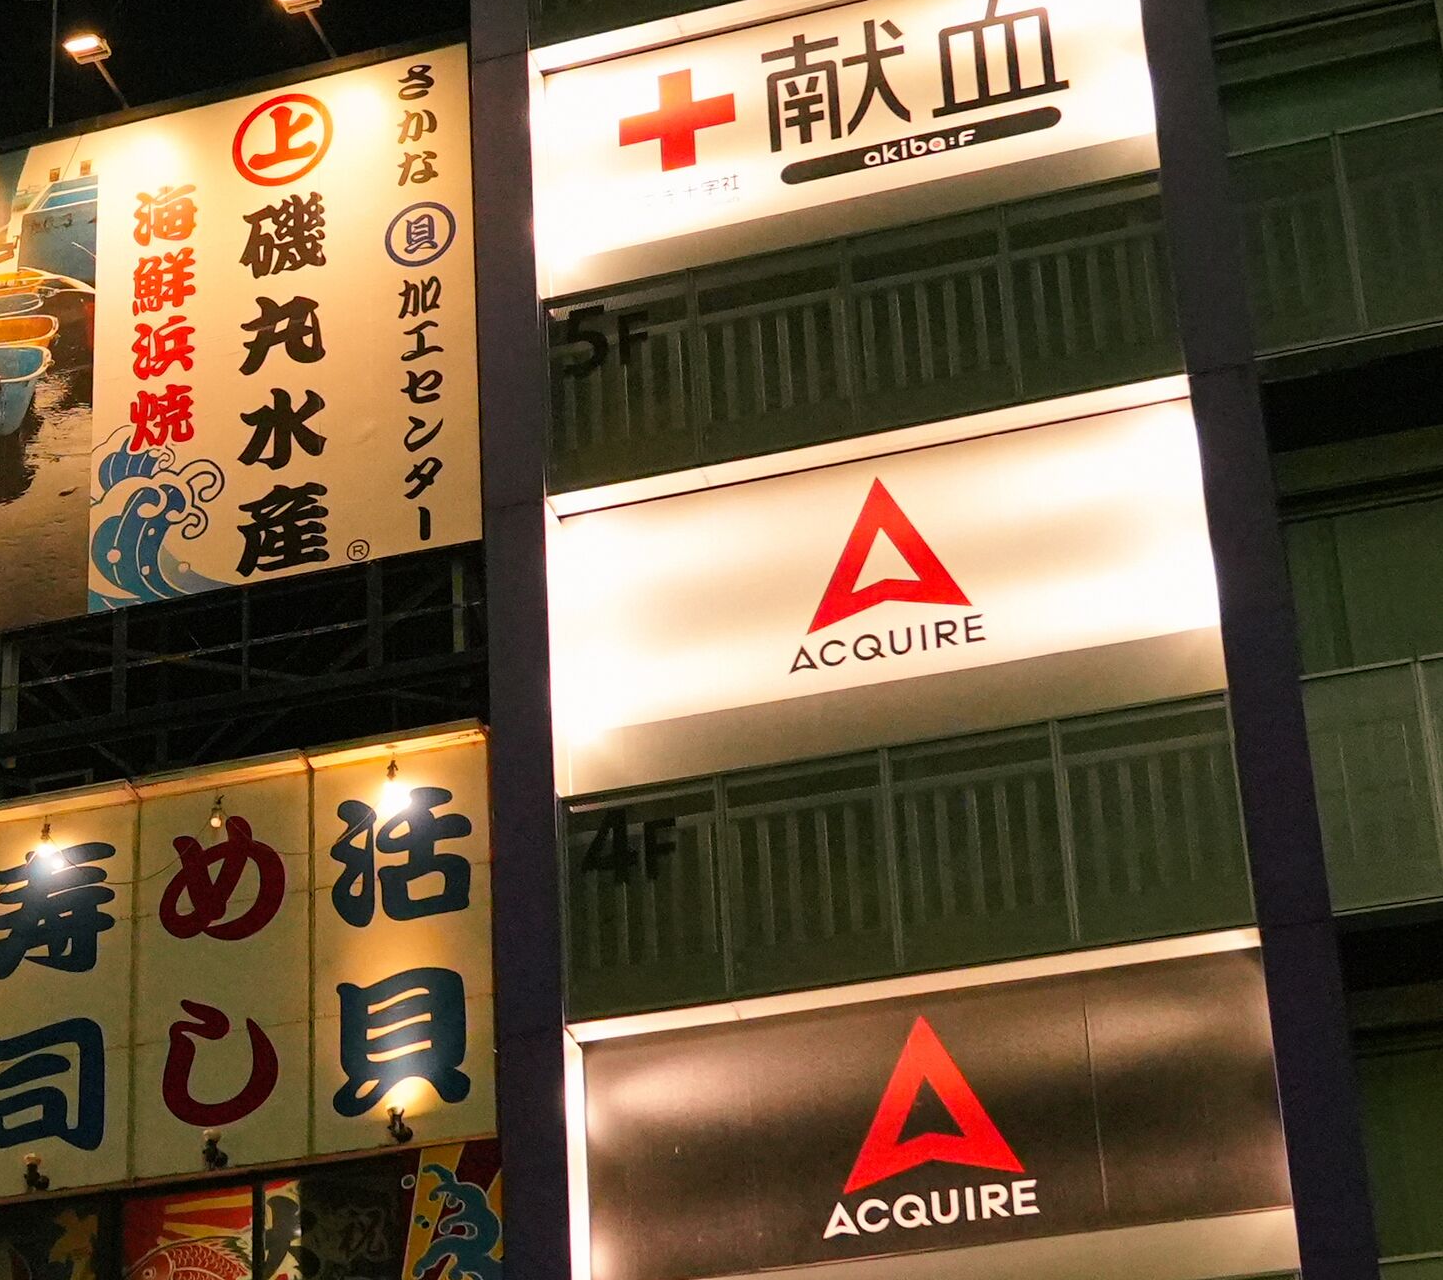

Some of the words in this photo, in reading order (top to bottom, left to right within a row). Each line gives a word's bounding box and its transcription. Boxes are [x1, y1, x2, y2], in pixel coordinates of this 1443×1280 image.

[396, 63, 441, 186] さかな
[128, 185, 200, 453] 海鮮浜焼
[238, 192, 331, 579] 磯丸水産
[398, 276, 445, 544] 加工センター
[563, 307, 649, 377] 5F
[788, 613, 987, 675] ACQUIRE
[580, 806, 682, 888] 4F
[160, 814, 286, 1128] めし
[330, 784, 473, 1119] 活貝
[821, 1178, 1042, 1242] ACQUIRE
